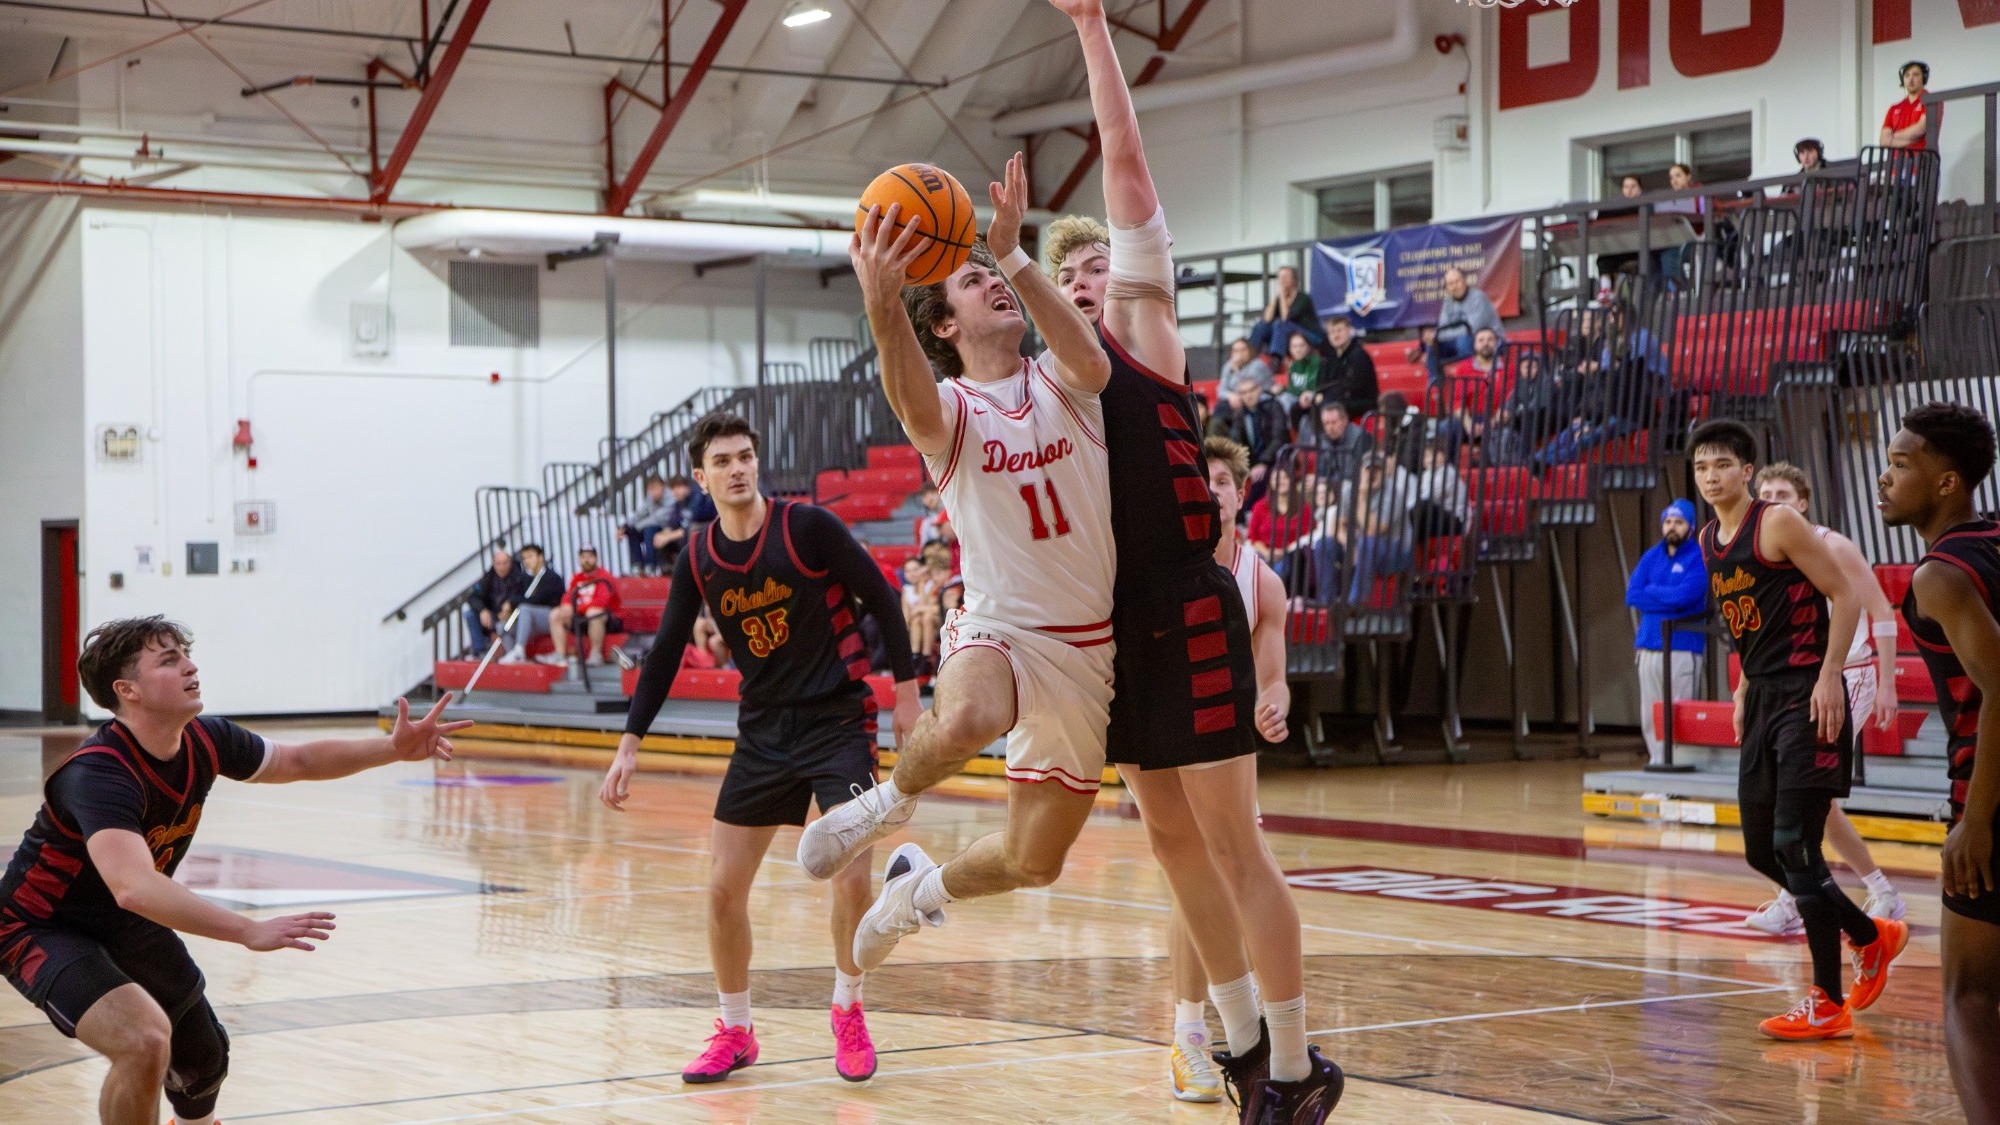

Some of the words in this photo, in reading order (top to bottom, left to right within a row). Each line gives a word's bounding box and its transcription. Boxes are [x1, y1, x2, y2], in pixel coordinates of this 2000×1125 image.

[1355, 266, 1377, 289] 50
[981, 436, 1073, 474] Denson
[1018, 477, 1072, 541] 11
[720, 576, 793, 617] Oberlin
[741, 607, 790, 658] 35
[1284, 870, 1558, 901] BIG
